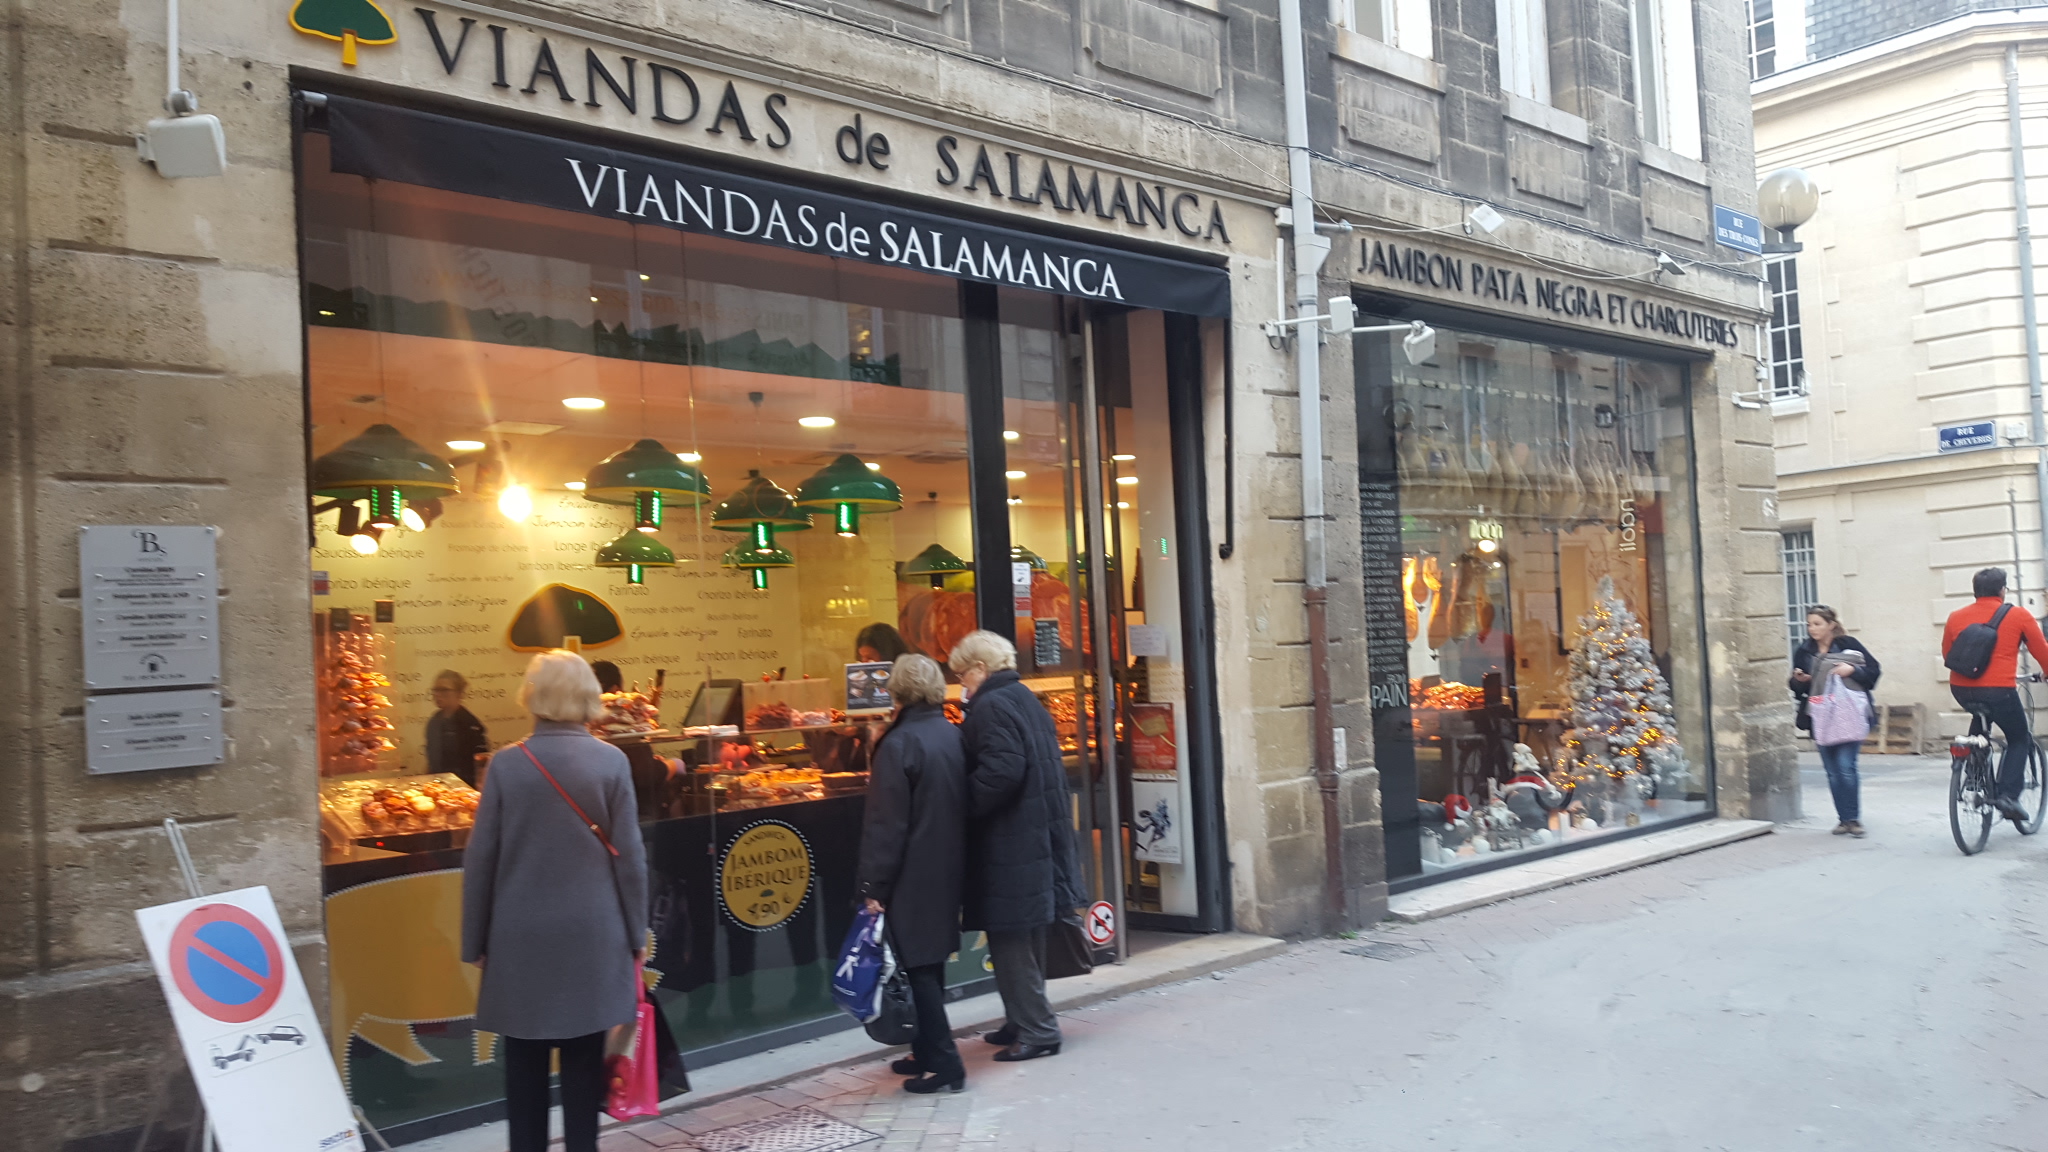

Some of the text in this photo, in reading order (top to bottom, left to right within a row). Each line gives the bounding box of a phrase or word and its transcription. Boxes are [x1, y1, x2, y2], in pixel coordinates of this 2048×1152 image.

[415, 7, 1232, 244] VIANDAS de SALAMANCA
[565, 157, 1125, 300] VIANDAS de SALAMANCA
[1357, 238, 1739, 348] JAMBON PATA NEGRA ET CHARCUTERIES
[1956, 426, 1975, 436] RUE
[1371, 683, 1408, 709] PAIN
